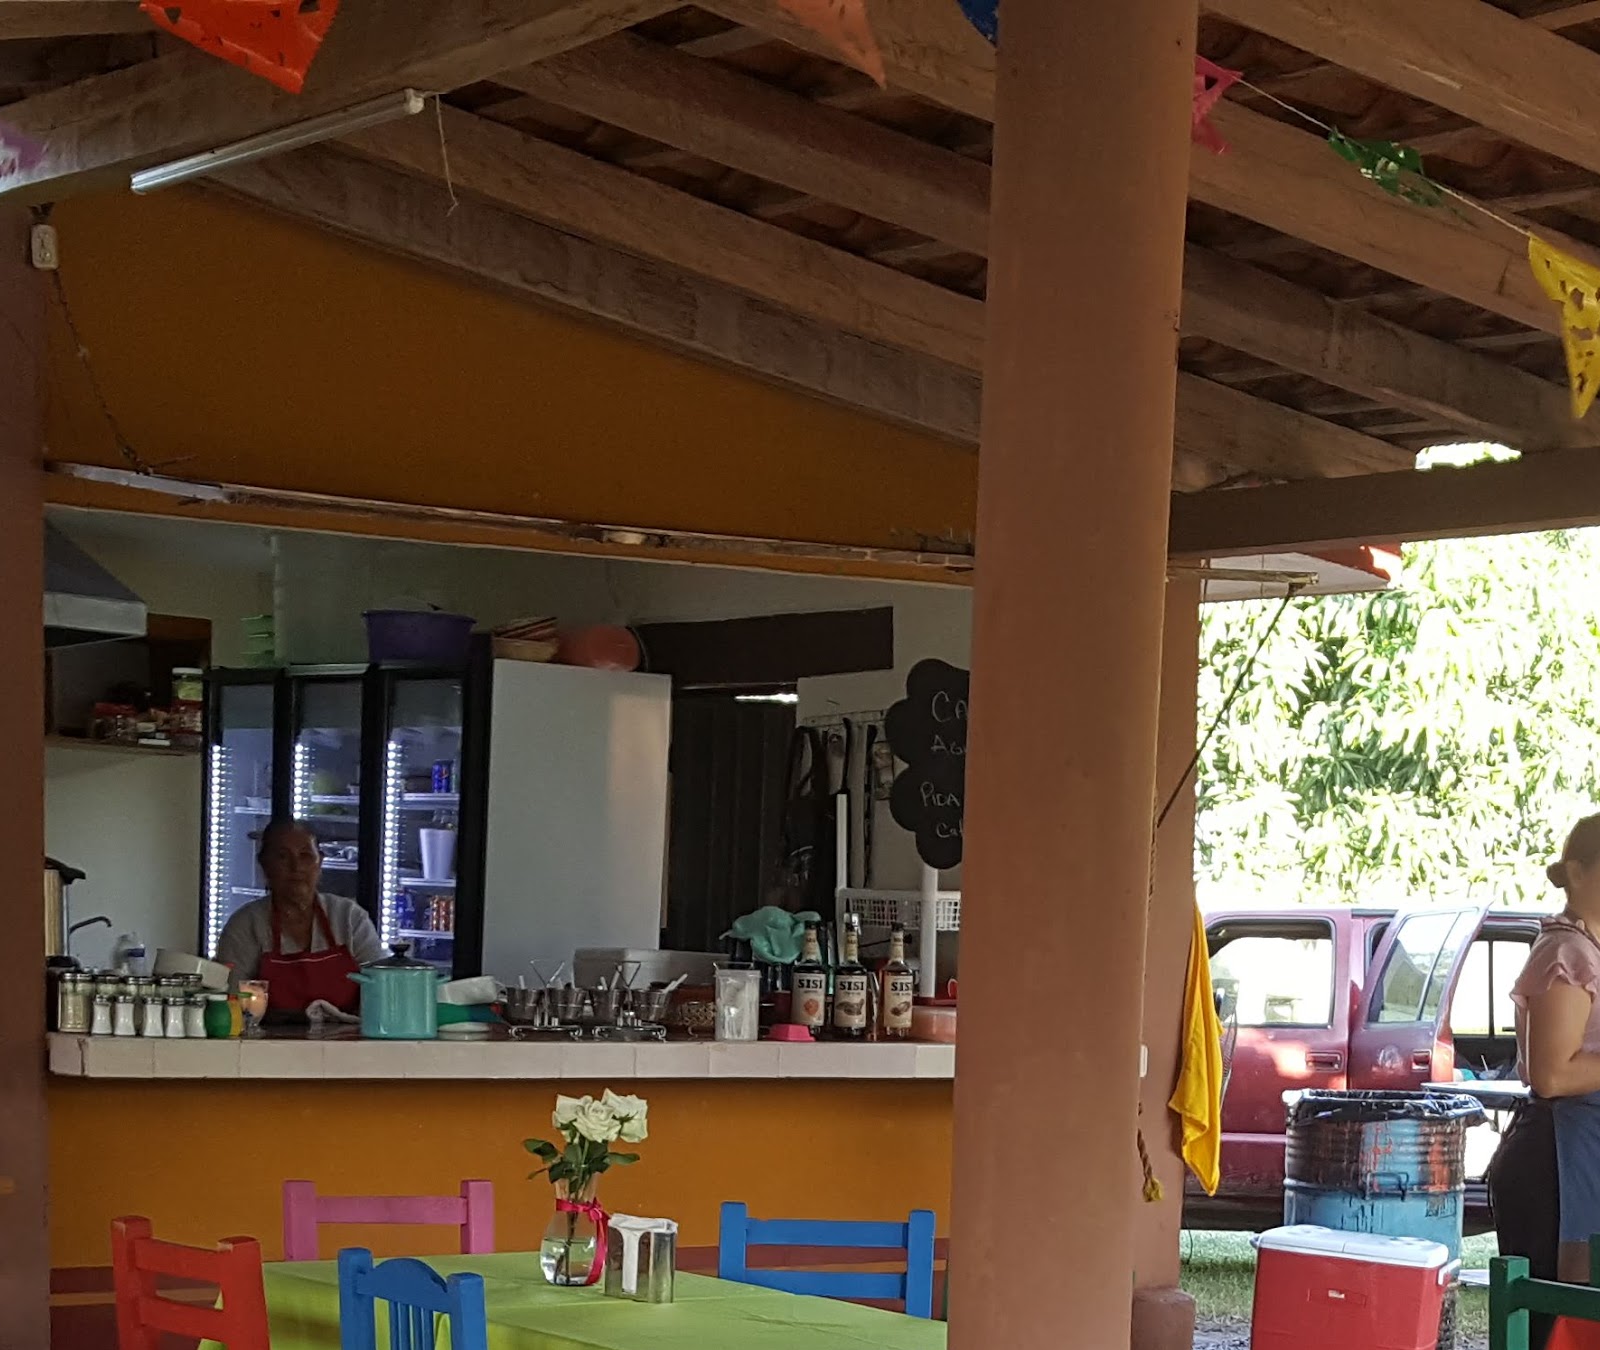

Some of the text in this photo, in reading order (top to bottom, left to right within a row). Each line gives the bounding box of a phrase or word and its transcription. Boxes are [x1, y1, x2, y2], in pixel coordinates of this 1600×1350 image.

[798, 979, 823, 989] SISI
[839, 981, 864, 991] SISI
[891, 982, 911, 991] SIS
